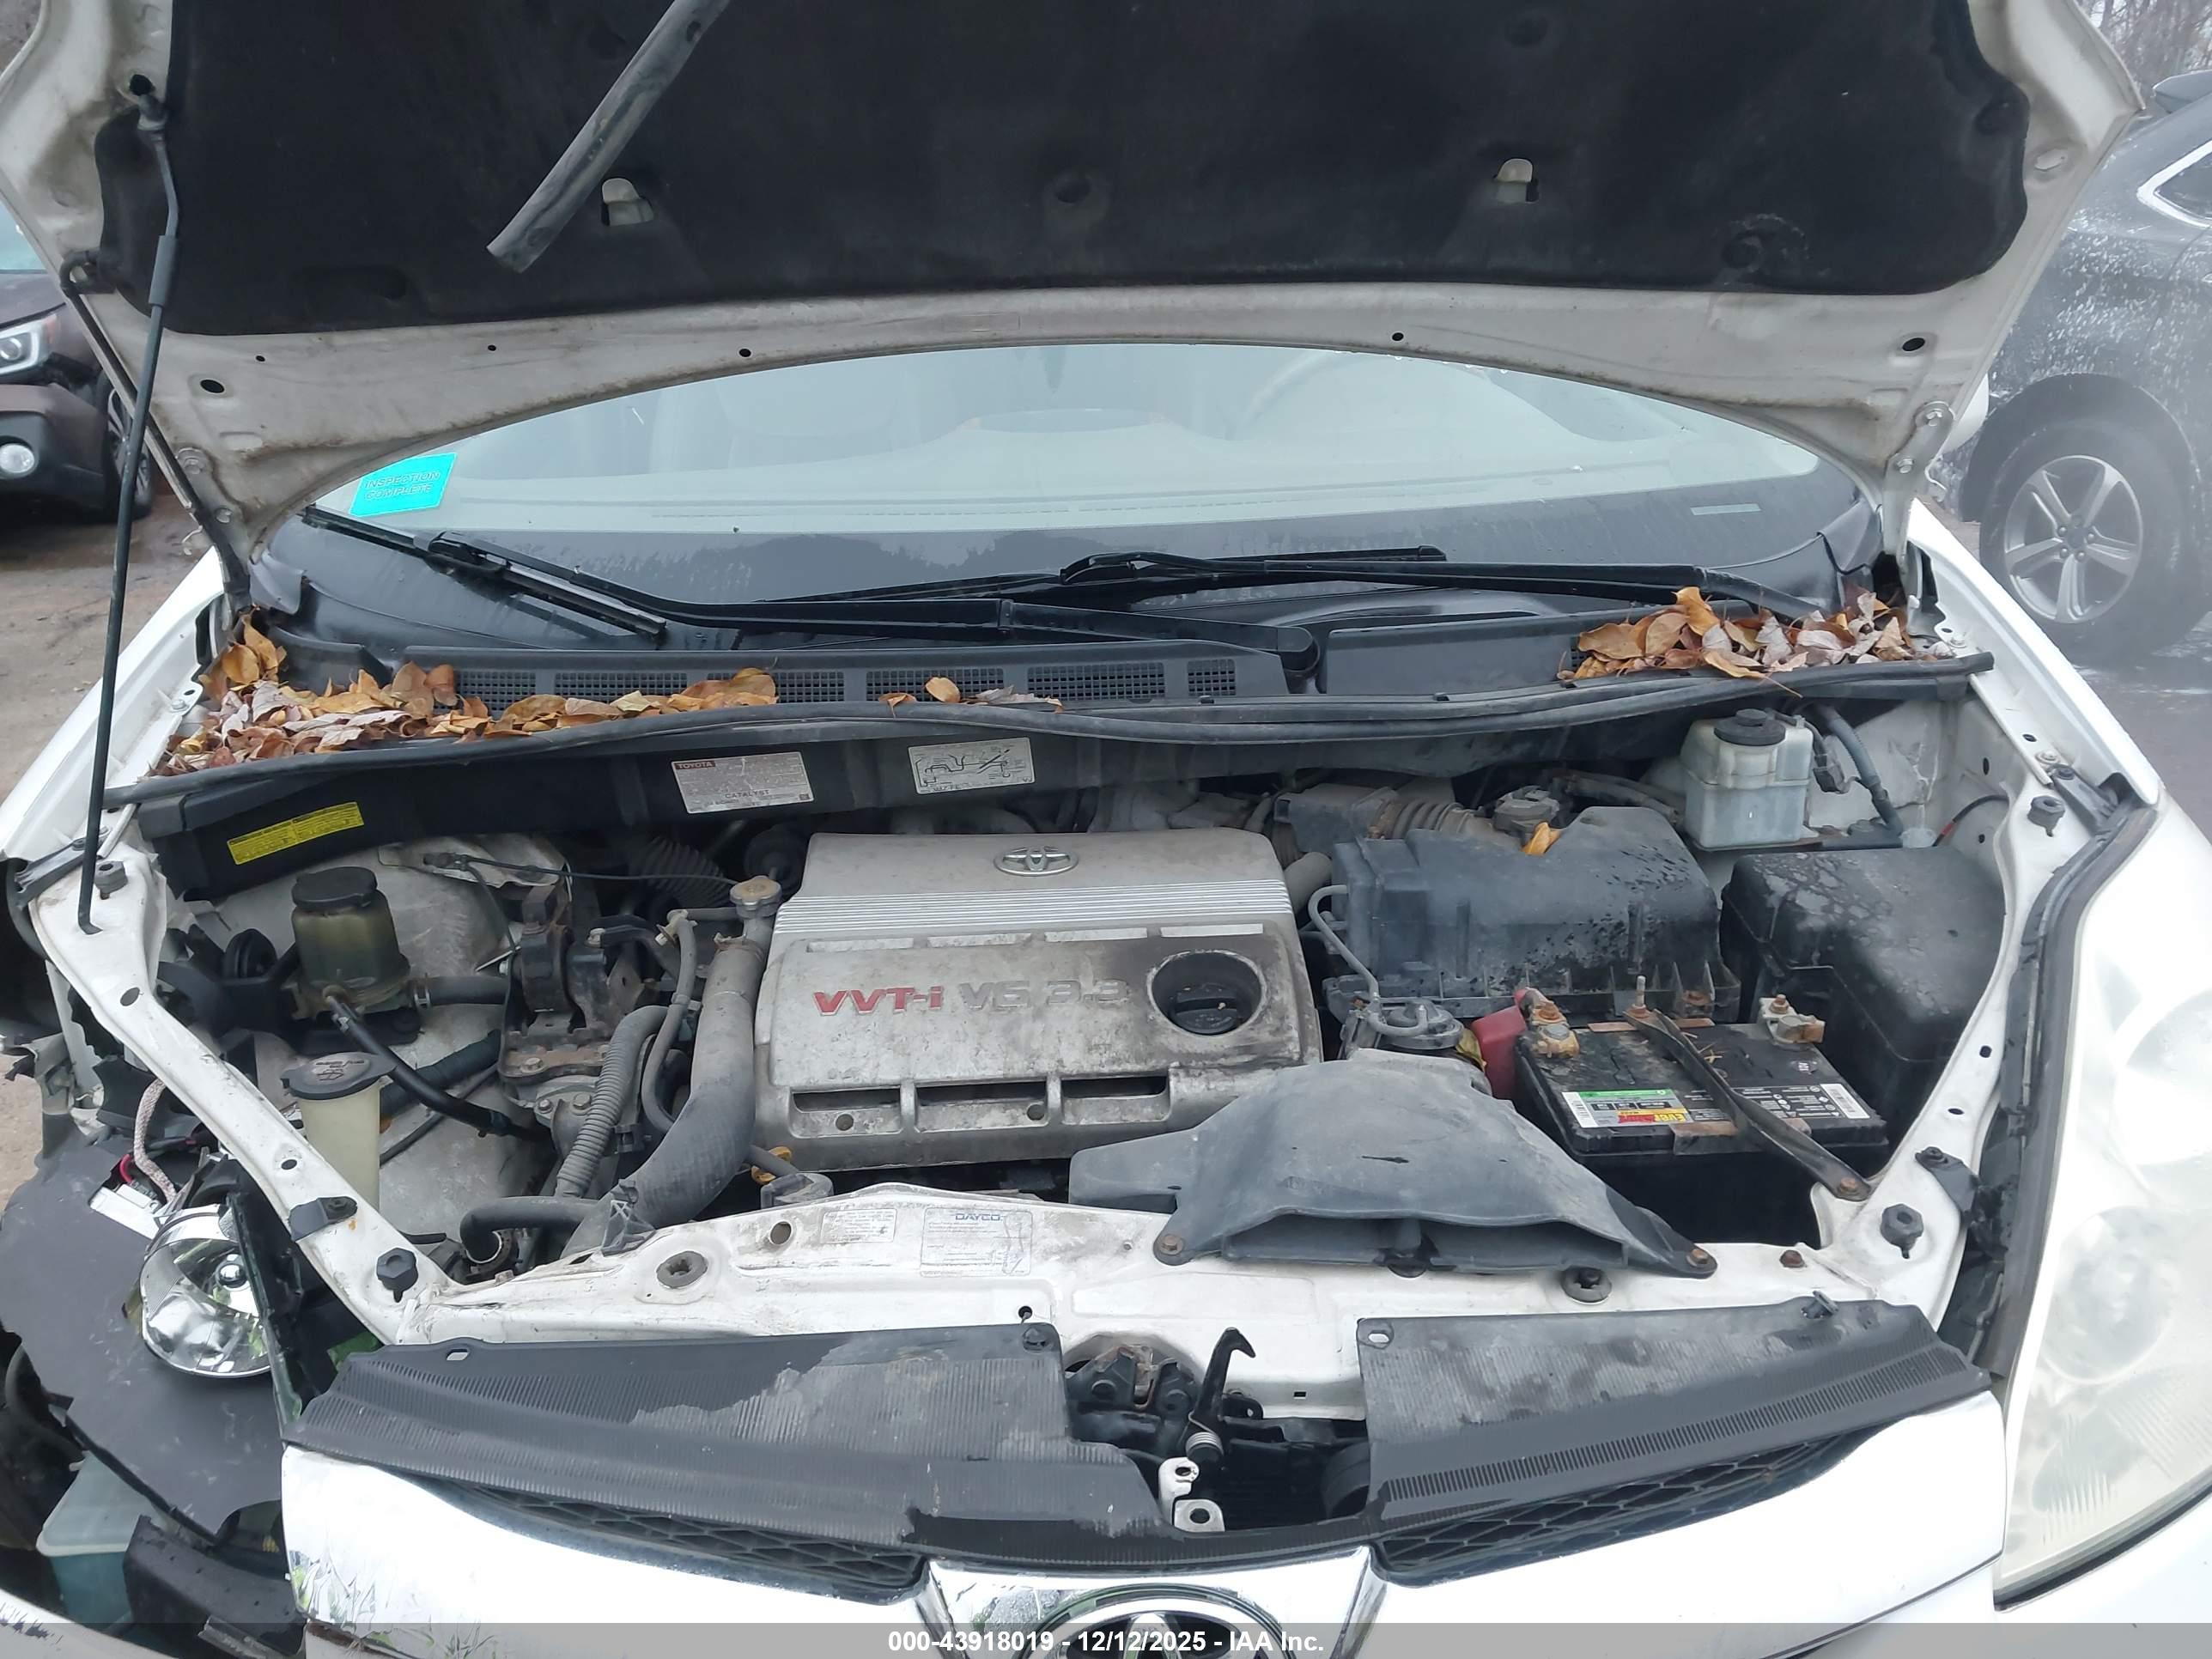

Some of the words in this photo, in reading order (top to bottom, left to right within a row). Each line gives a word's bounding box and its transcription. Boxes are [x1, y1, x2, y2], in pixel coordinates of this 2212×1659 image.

[365, 471, 441, 488] INSPECTION
[365, 483, 434, 500] COMPLETE
[725, 789, 770, 799] CATALYST
[814, 985, 944, 1016] VVT-i
[959, 980, 1030, 1010] V6
